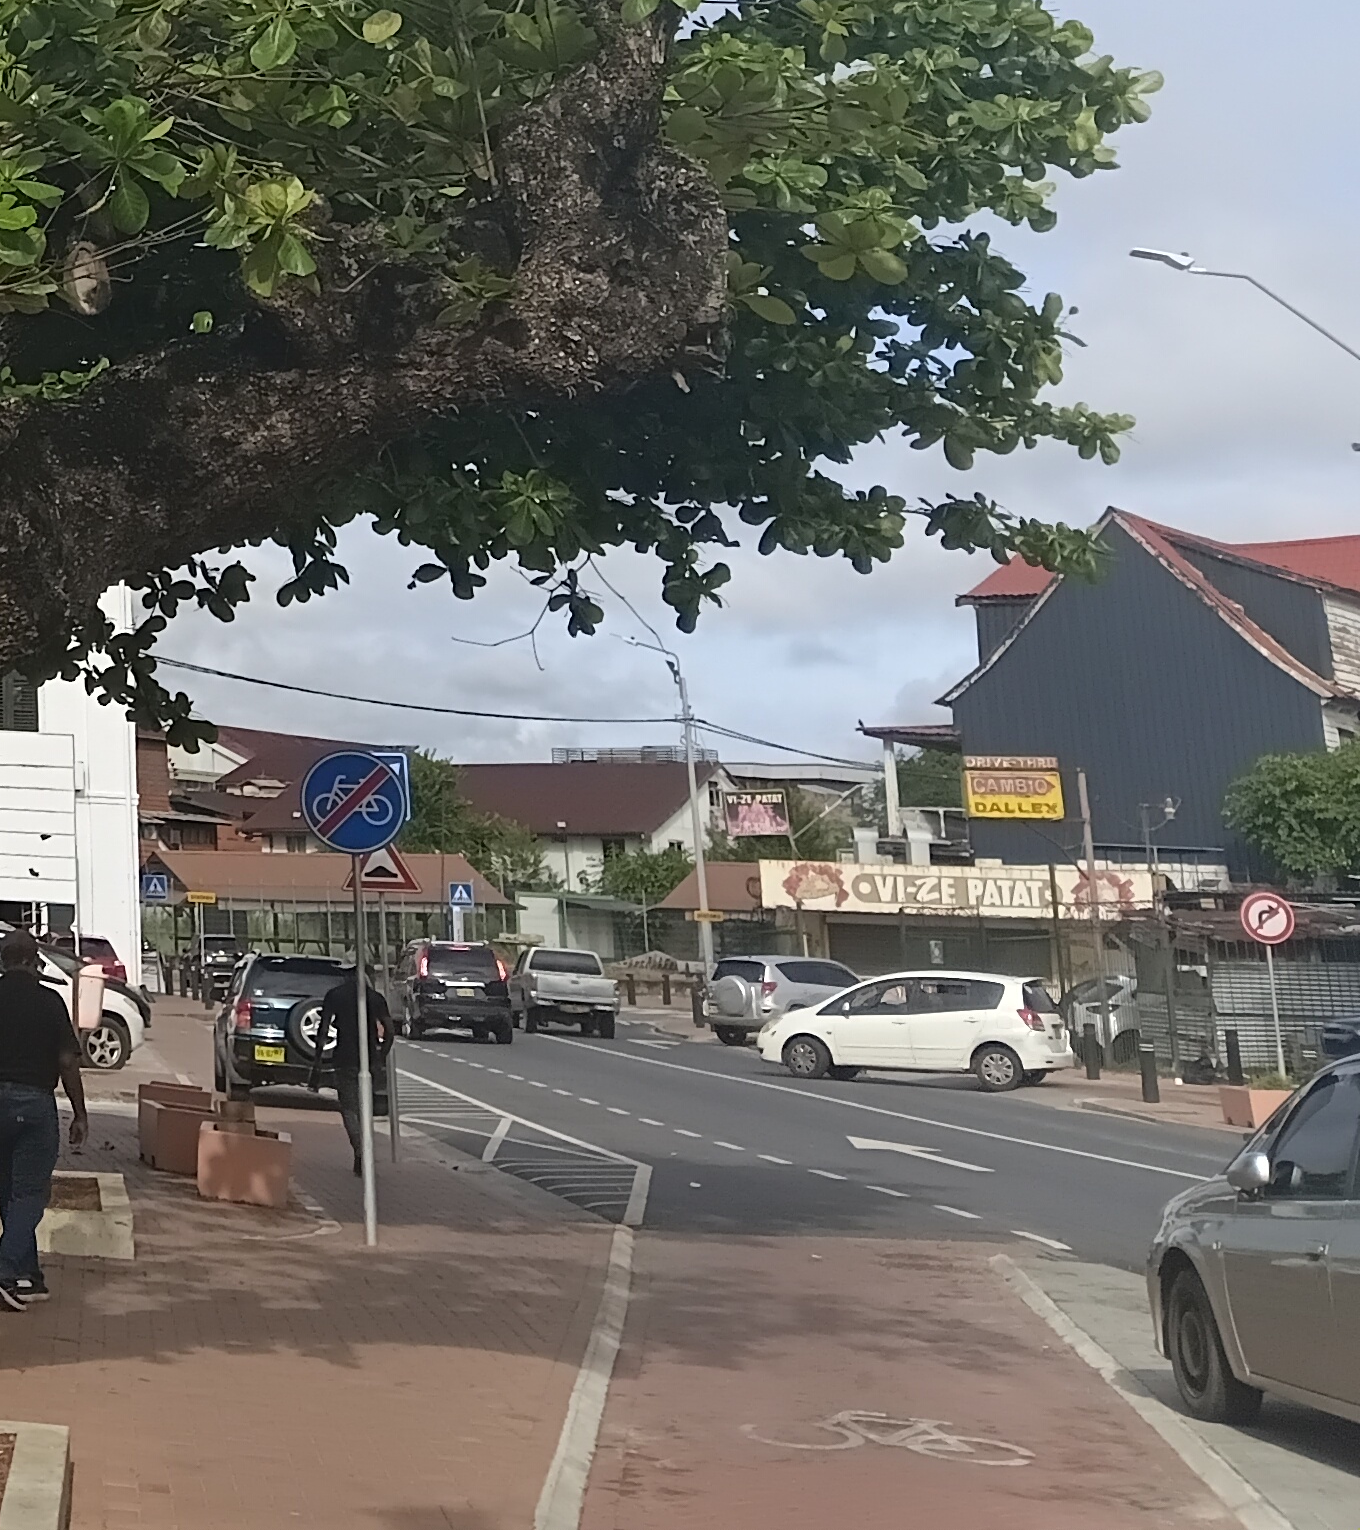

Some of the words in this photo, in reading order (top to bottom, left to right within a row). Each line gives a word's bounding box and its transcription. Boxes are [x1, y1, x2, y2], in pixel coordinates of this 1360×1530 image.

[972, 778, 1048, 793] CAMBIO
[974, 801, 1058, 814] DALLEX
[873, 875, 956, 905] VI-ZE
[967, 878, 1043, 907] PATAT
